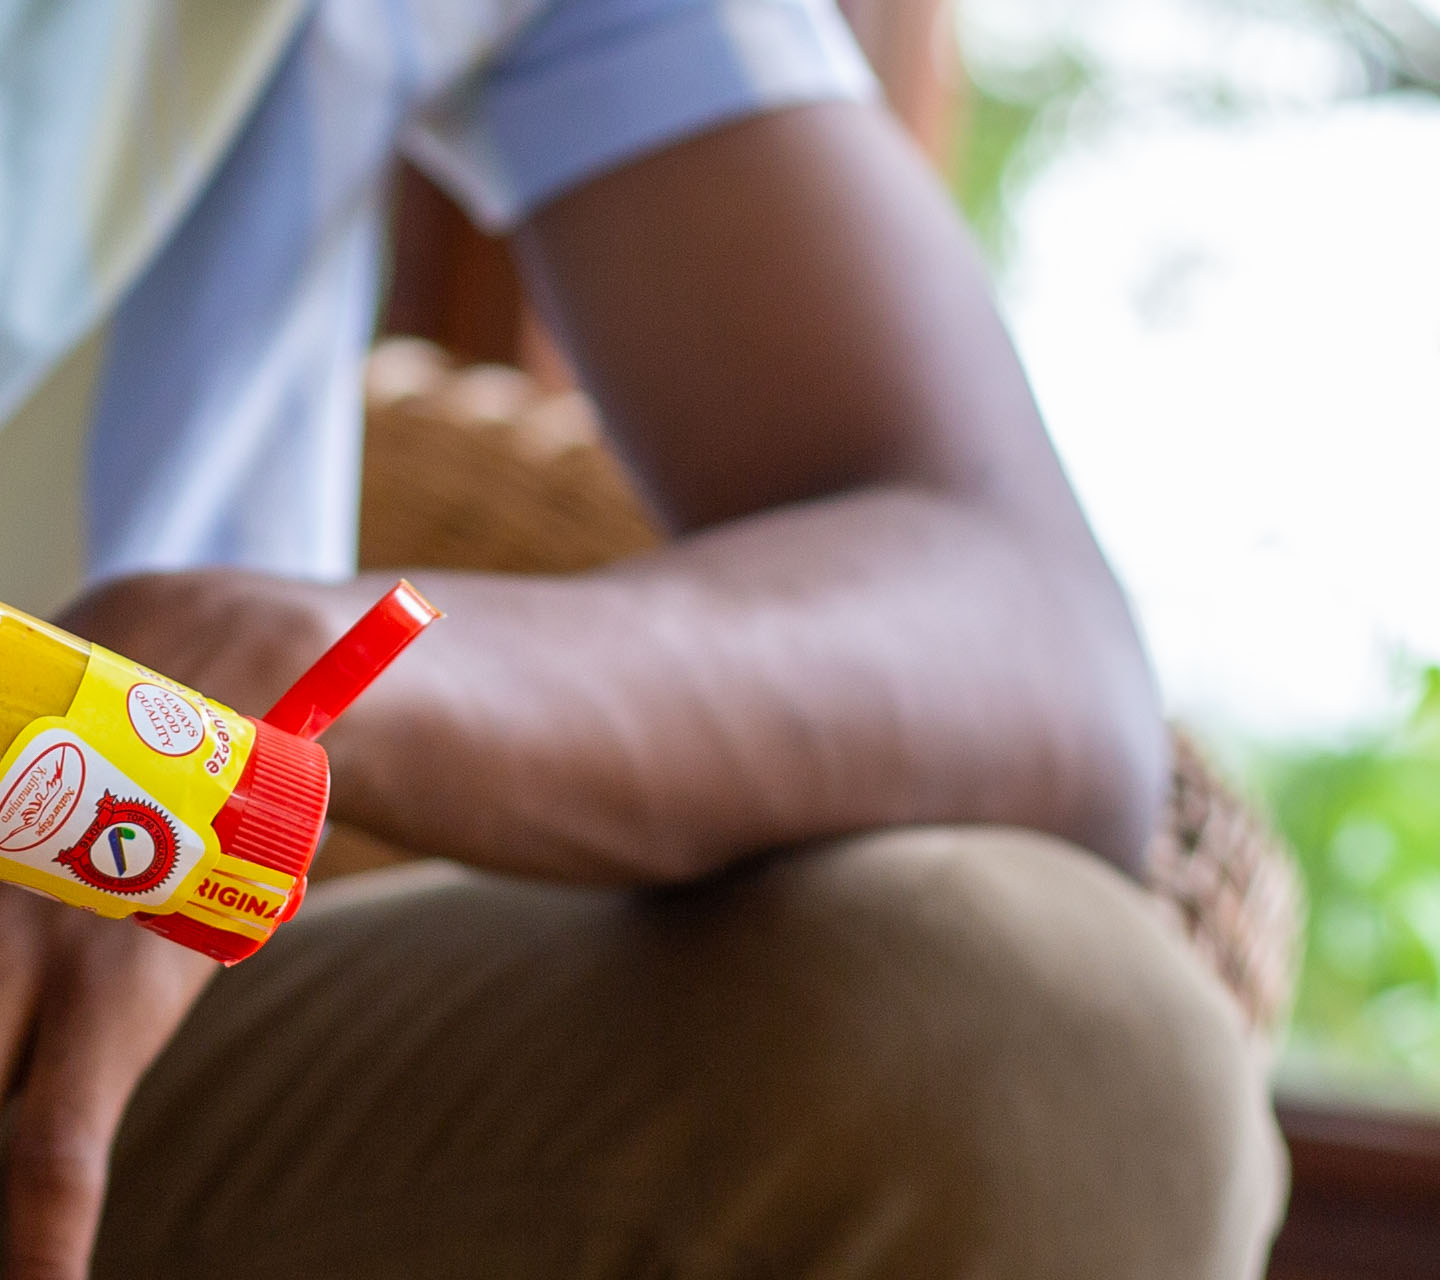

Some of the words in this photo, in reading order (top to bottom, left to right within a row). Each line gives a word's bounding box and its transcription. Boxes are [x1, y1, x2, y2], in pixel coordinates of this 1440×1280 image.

[135, 690, 174, 748] QUALITY
[153, 696, 182, 734] GOOD
[159, 690, 199, 738] ALWAYS
